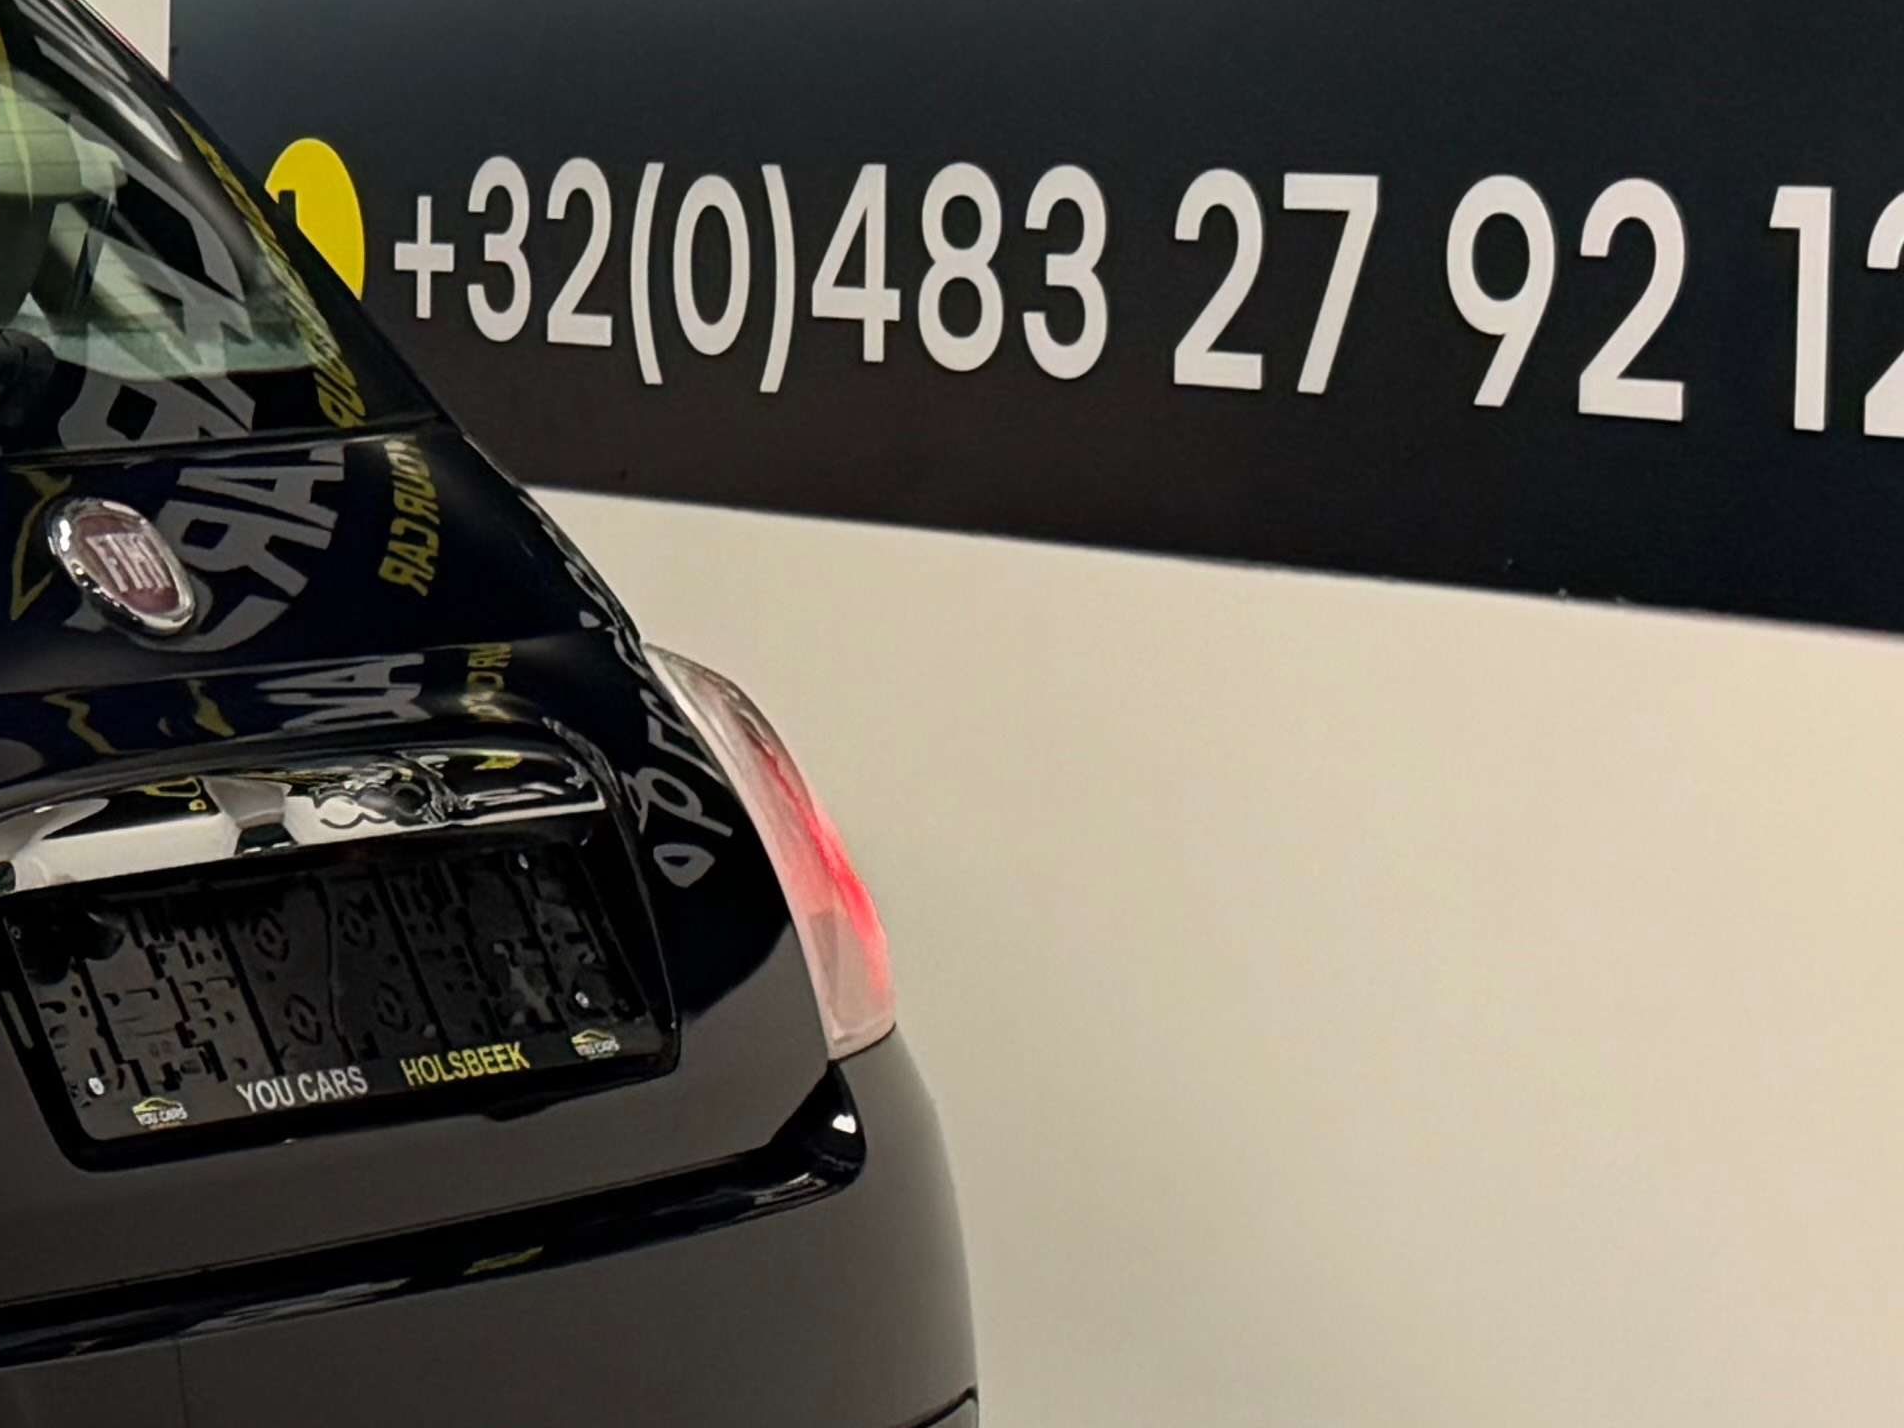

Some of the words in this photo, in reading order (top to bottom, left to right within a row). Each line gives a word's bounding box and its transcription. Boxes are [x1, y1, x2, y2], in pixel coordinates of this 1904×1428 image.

[394, 155, 1108, 393] +32(0)483
[1174, 168, 1379, 394] 27
[1446, 174, 1686, 421] 92
[85, 532, 173, 593] FIAT
[234, 1074, 295, 1113] YOU
[297, 1065, 369, 1103] CARS
[399, 1041, 531, 1088] HOLSBEEK
